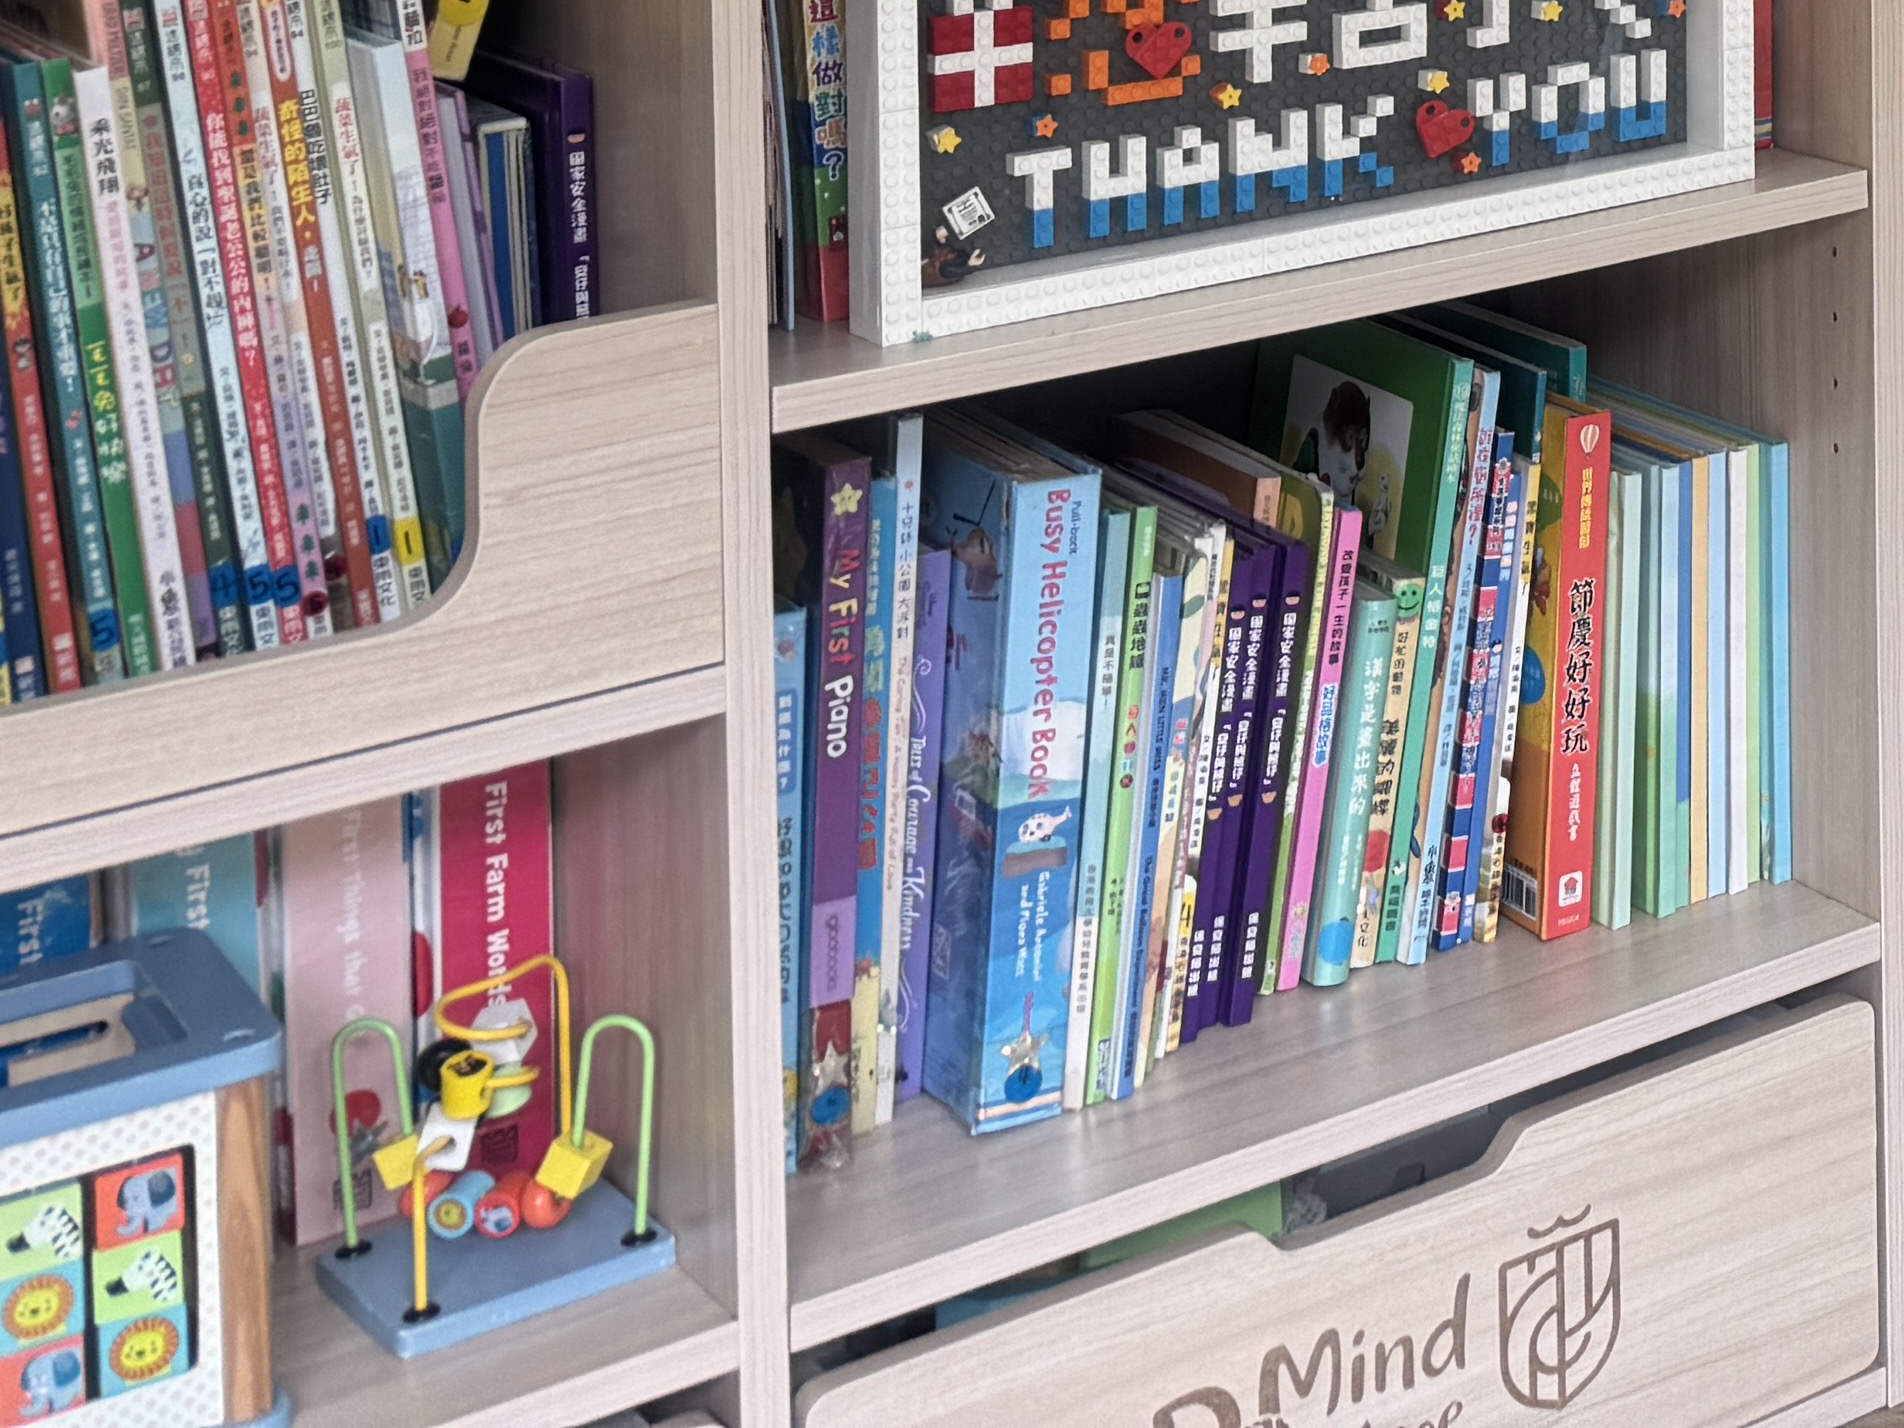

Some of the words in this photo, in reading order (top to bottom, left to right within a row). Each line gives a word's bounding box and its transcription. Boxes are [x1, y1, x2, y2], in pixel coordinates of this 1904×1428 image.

[1006, 94, 1395, 248] THANK
[1467, 48, 1668, 166] YOU
[1040, 488, 1072, 554] Busy
[1068, 500, 1082, 555] Pull-back
[829, 548, 862, 590] My
[827, 597, 860, 666] First
[1029, 560, 1069, 724] Helicopter
[1559, 576, 1599, 757] 節慶好好玩
[823, 674, 856, 760] Piano
[1027, 727, 1057, 800] Book
[483, 780, 509, 847] First
[904, 781, 931, 855] Courage
[183, 863, 212, 930] First
[483, 851, 510, 924] Farm
[899, 865, 926, 951] Kindness
[1258, 1271, 1471, 1418] Mind
